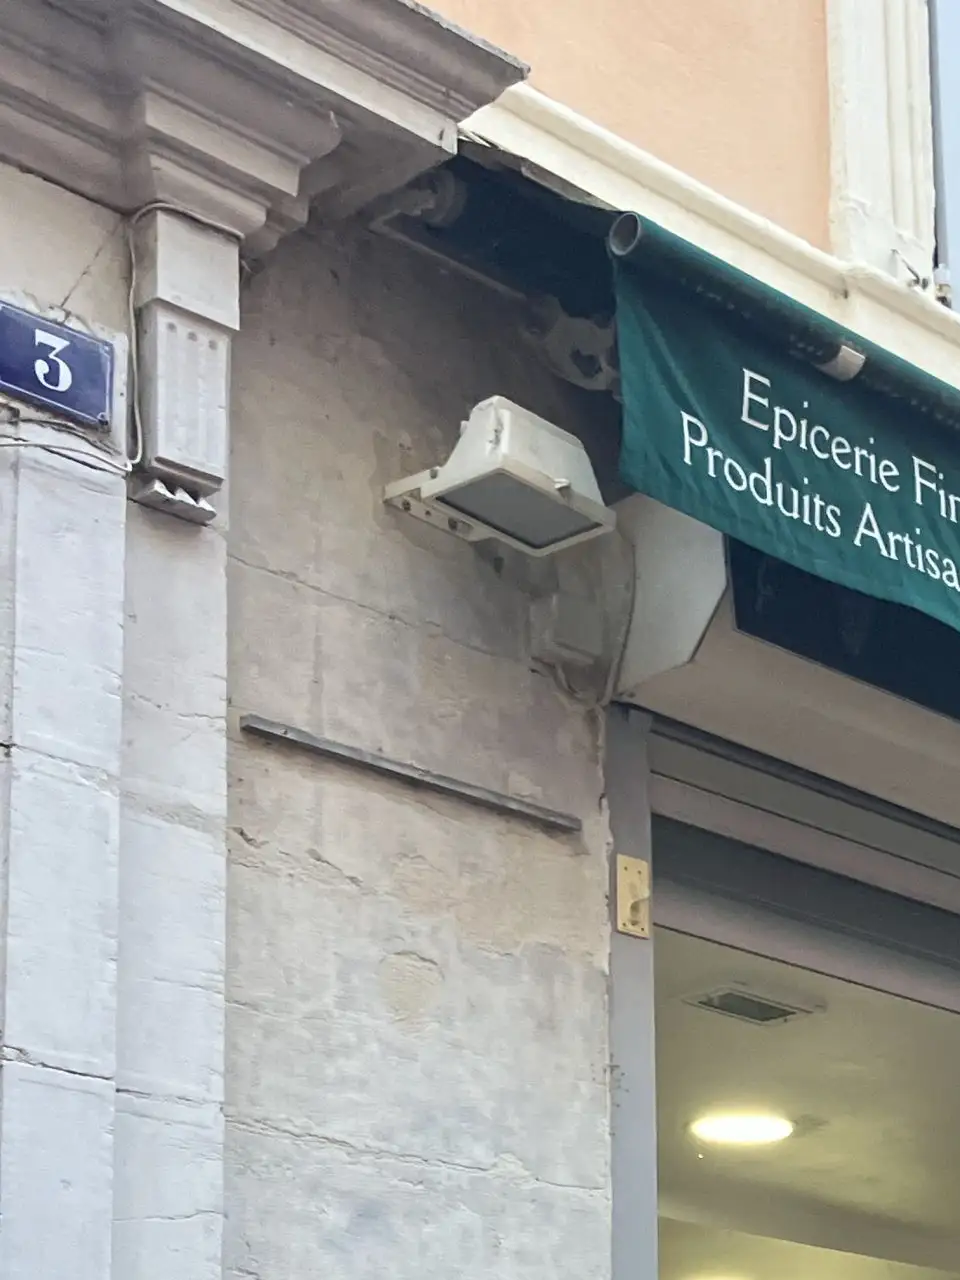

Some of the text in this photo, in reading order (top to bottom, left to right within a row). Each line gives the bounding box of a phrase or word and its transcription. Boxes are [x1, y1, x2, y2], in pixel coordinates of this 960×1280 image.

[34, 328, 72, 392] 3
[680, 411, 841, 537] Produits
[741, 368, 900, 493] Epicerie
